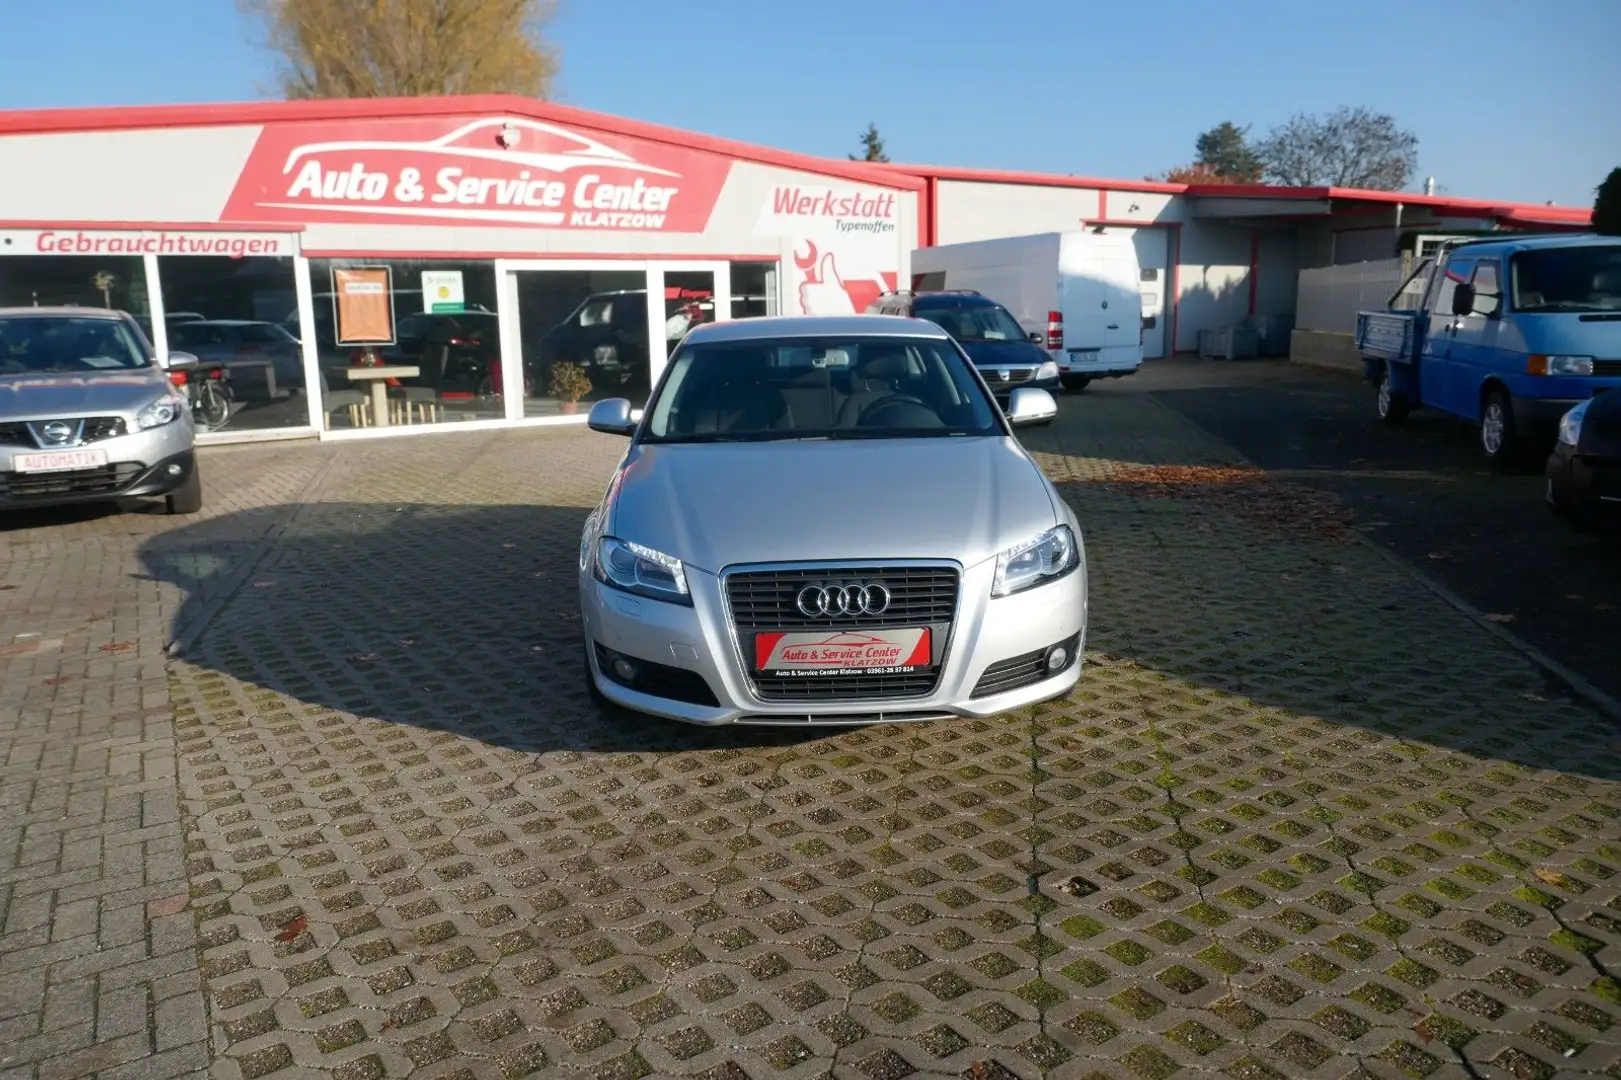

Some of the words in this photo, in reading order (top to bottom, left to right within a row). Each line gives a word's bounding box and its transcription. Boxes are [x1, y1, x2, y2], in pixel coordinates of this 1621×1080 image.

[286, 159, 389, 201] Auto
[393, 167, 424, 202] &
[431, 167, 566, 206] Service
[574, 174, 679, 212] Center
[774, 187, 894, 218] Werkstatt
[570, 211, 665, 229] KLATZOW
[835, 219, 894, 234] Typenoffen
[36, 232, 278, 259] Gebrauchtwagen
[25, 452, 102, 468] AUTOMATIK
[782, 649, 808, 660] Auto
[811, 650, 818, 659] &
[822, 648, 862, 660] Service
[866, 647, 902, 658] Center
[844, 658, 897, 667] KLATZOW
